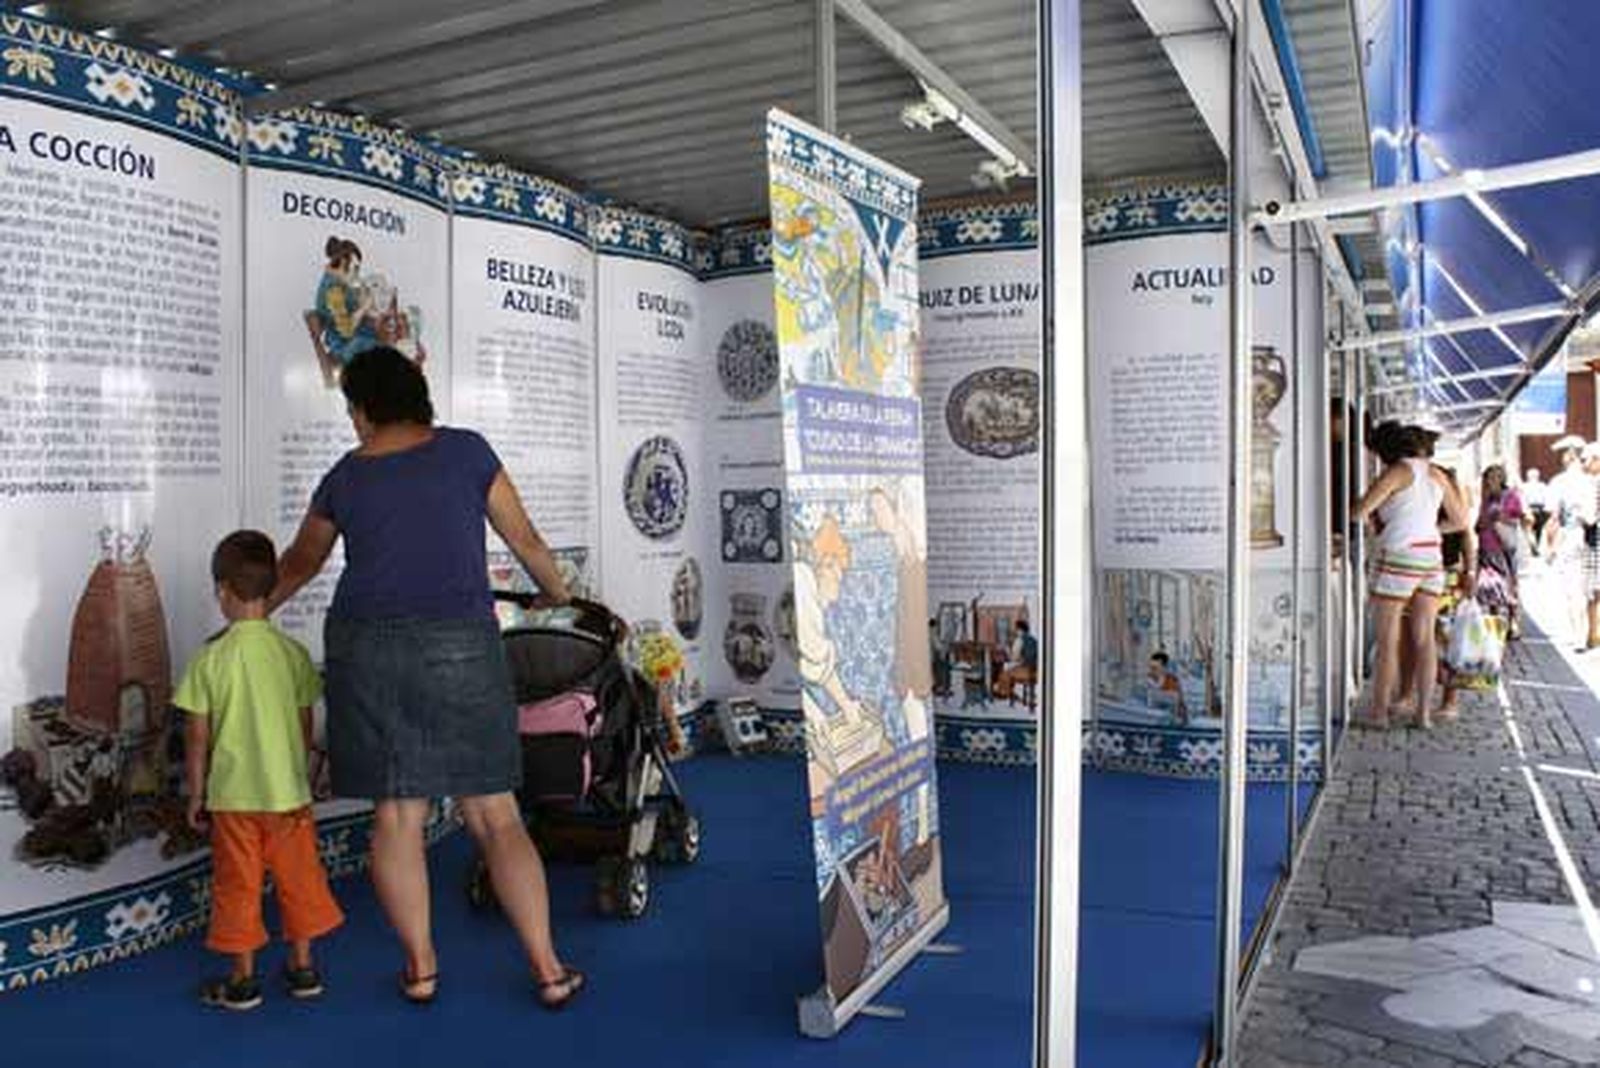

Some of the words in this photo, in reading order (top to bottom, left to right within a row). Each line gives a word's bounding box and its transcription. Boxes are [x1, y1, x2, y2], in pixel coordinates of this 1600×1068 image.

[0, 125, 17, 153] A
[29, 131, 155, 179] COCCIÓN
[487, 258, 556, 290] BELLEZA
[1132, 266, 1275, 291] ACTUALID
[959, 285, 984, 305] DE
